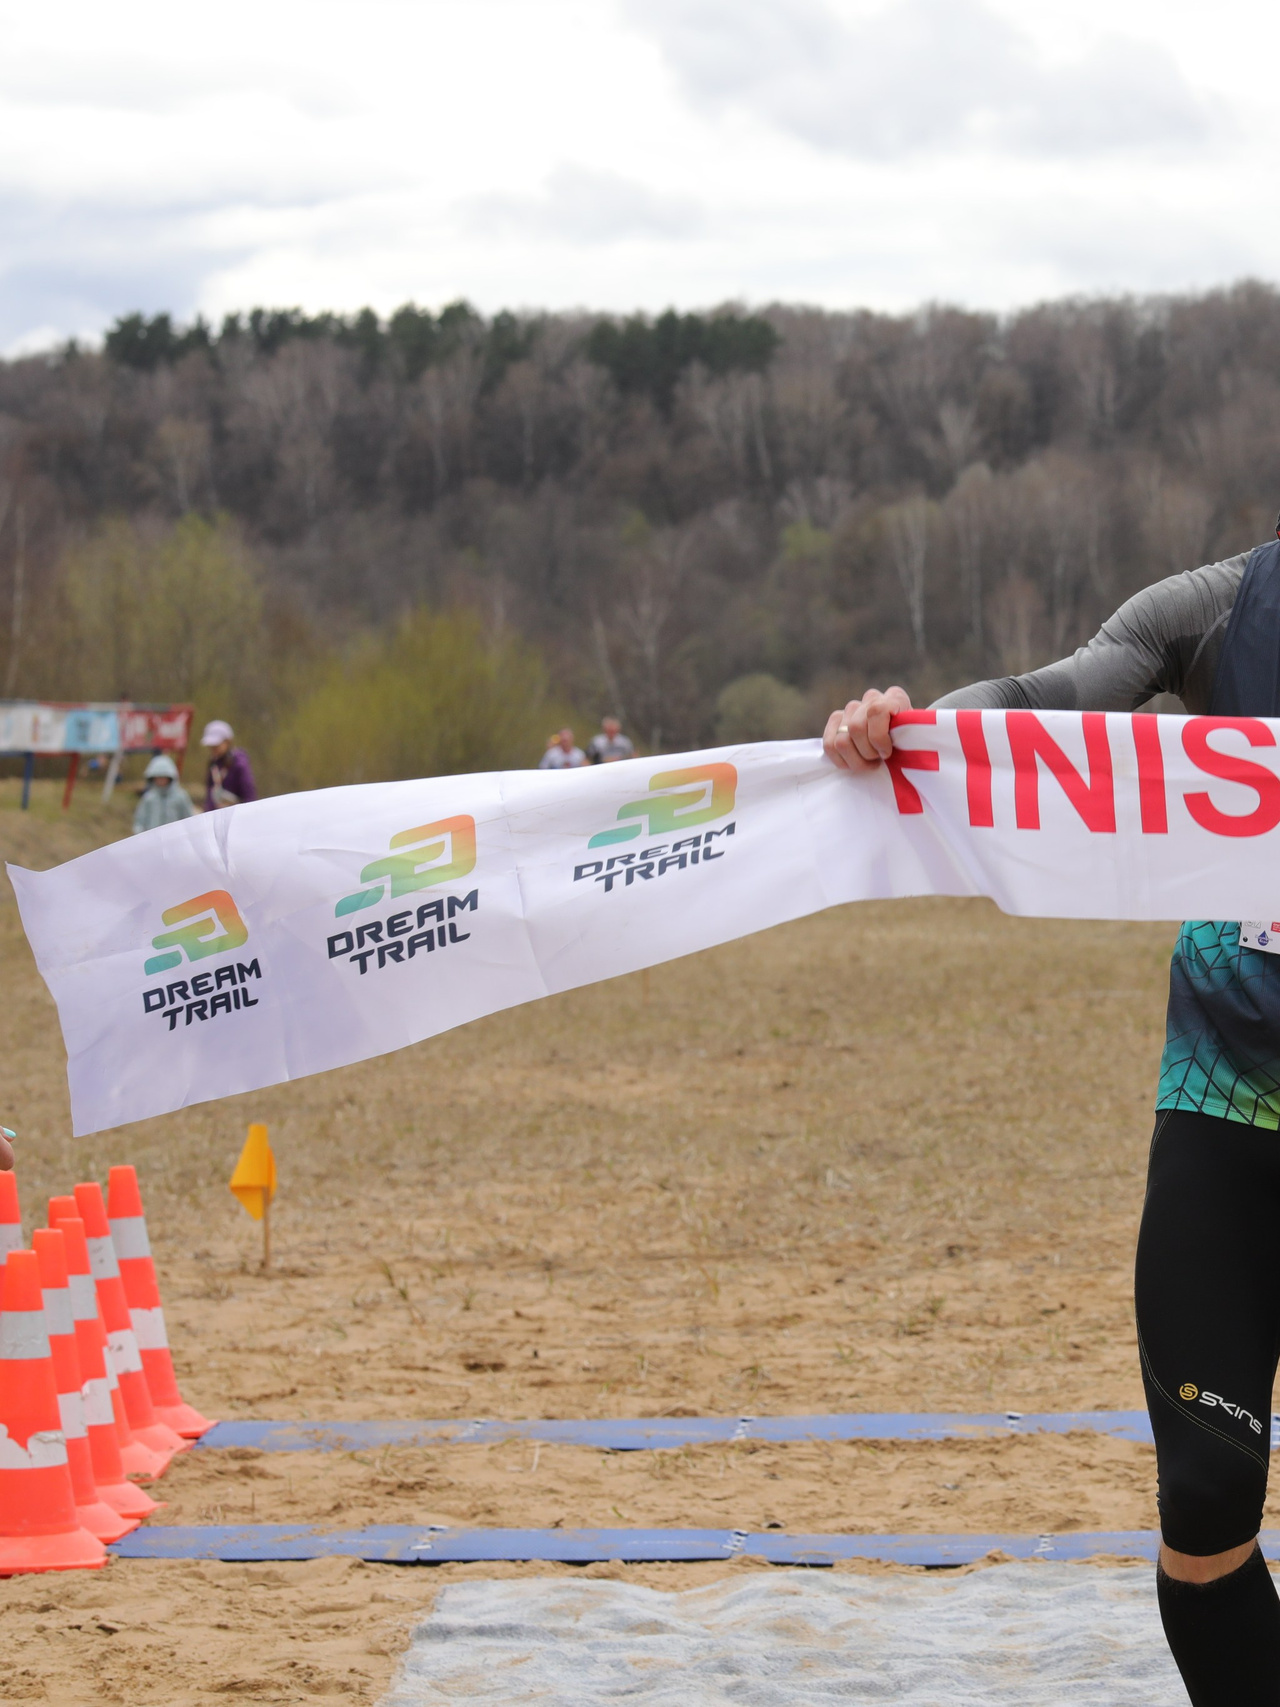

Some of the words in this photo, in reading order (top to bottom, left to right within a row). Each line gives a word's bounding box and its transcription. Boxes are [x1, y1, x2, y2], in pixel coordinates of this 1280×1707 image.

[572, 821, 737, 882] DREAM
[595, 846, 726, 893] TRAIL
[326, 889, 479, 959] DREAM
[349, 922, 471, 975] TRAIL
[142, 957, 262, 1013] DREAM
[162, 987, 259, 1031] TRAIL
